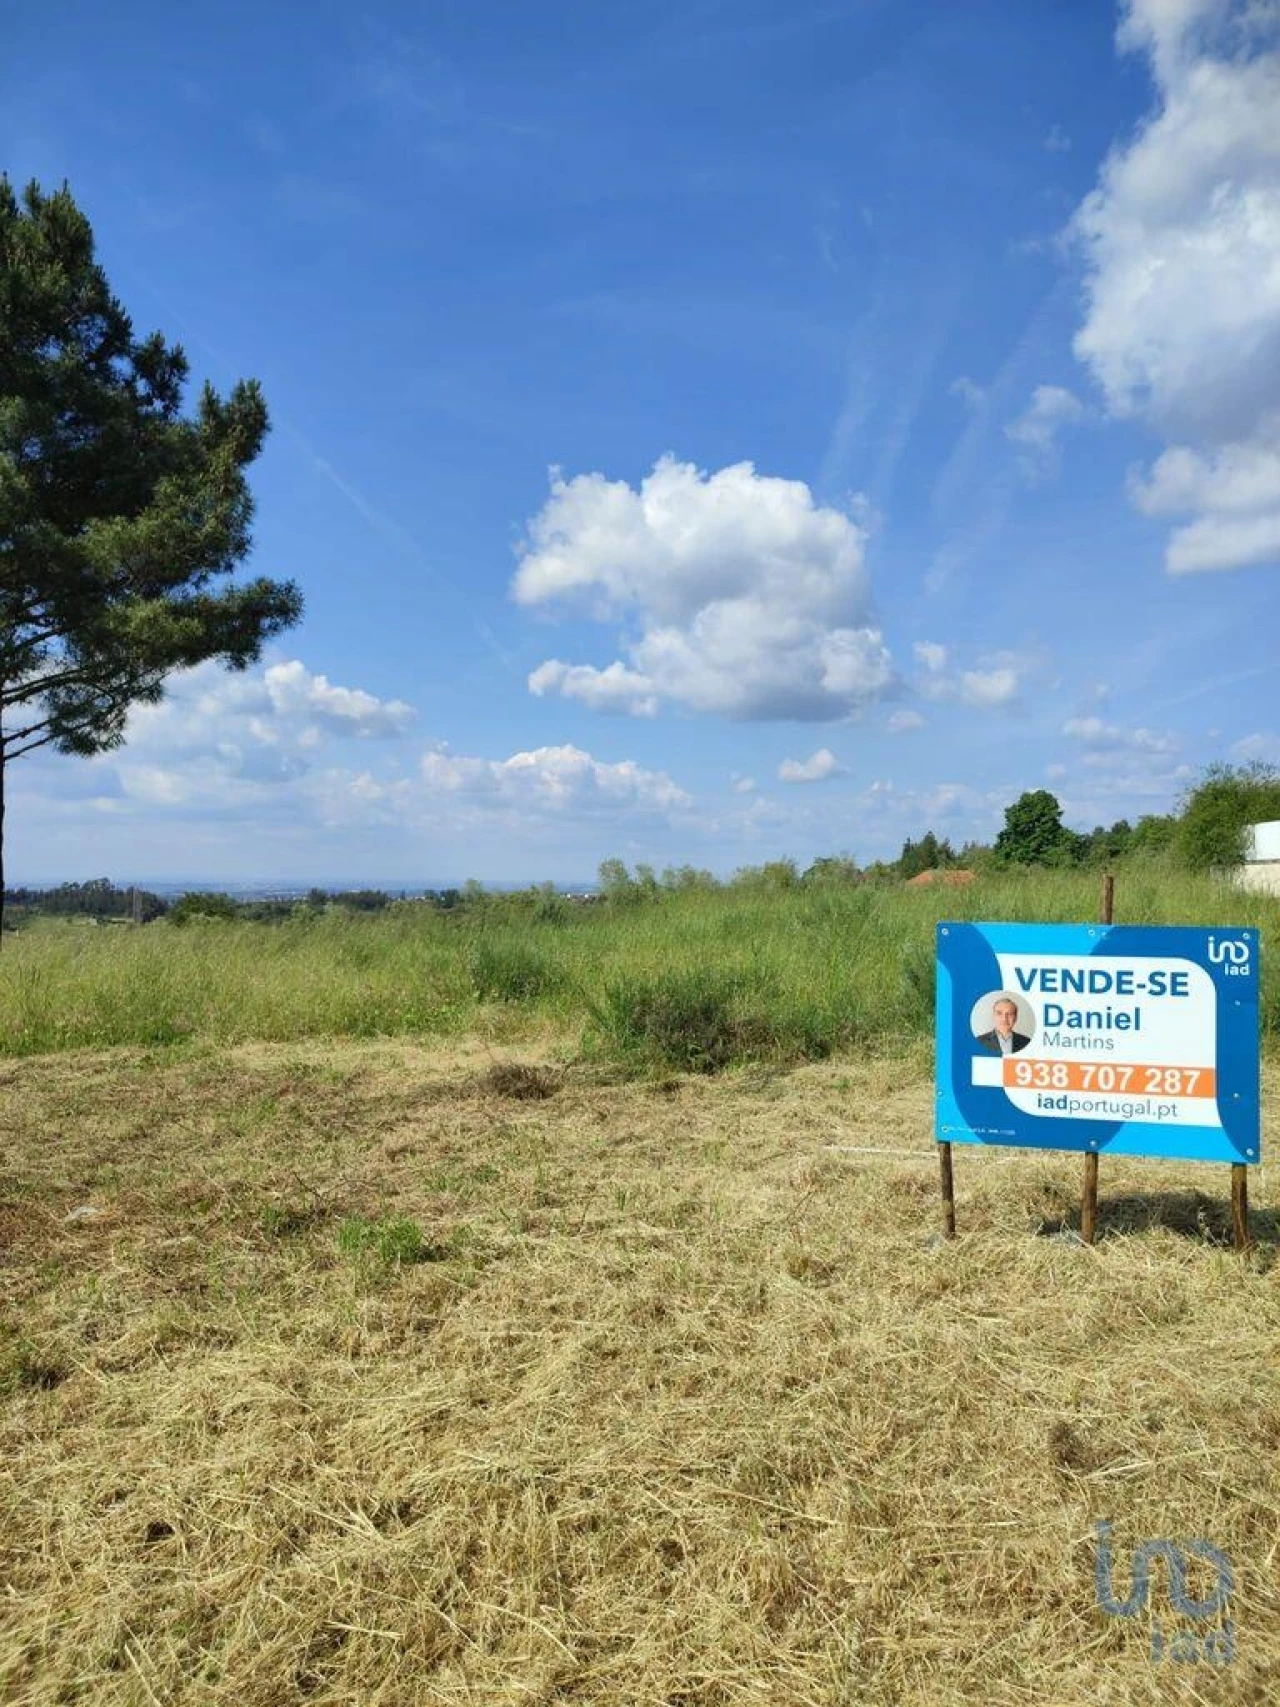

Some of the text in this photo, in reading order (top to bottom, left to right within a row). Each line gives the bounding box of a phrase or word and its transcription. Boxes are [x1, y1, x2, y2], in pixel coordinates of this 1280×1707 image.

[1014, 966, 1190, 997] VENDE-SE
[1225, 963, 1250, 976] iad
[1043, 1003, 1142, 1031] Daniel
[1042, 1031, 1115, 1051] Martins
[1014, 1061, 1201, 1095] 938 707 287
[1037, 1093, 1178, 1120] iadportugal.pt
